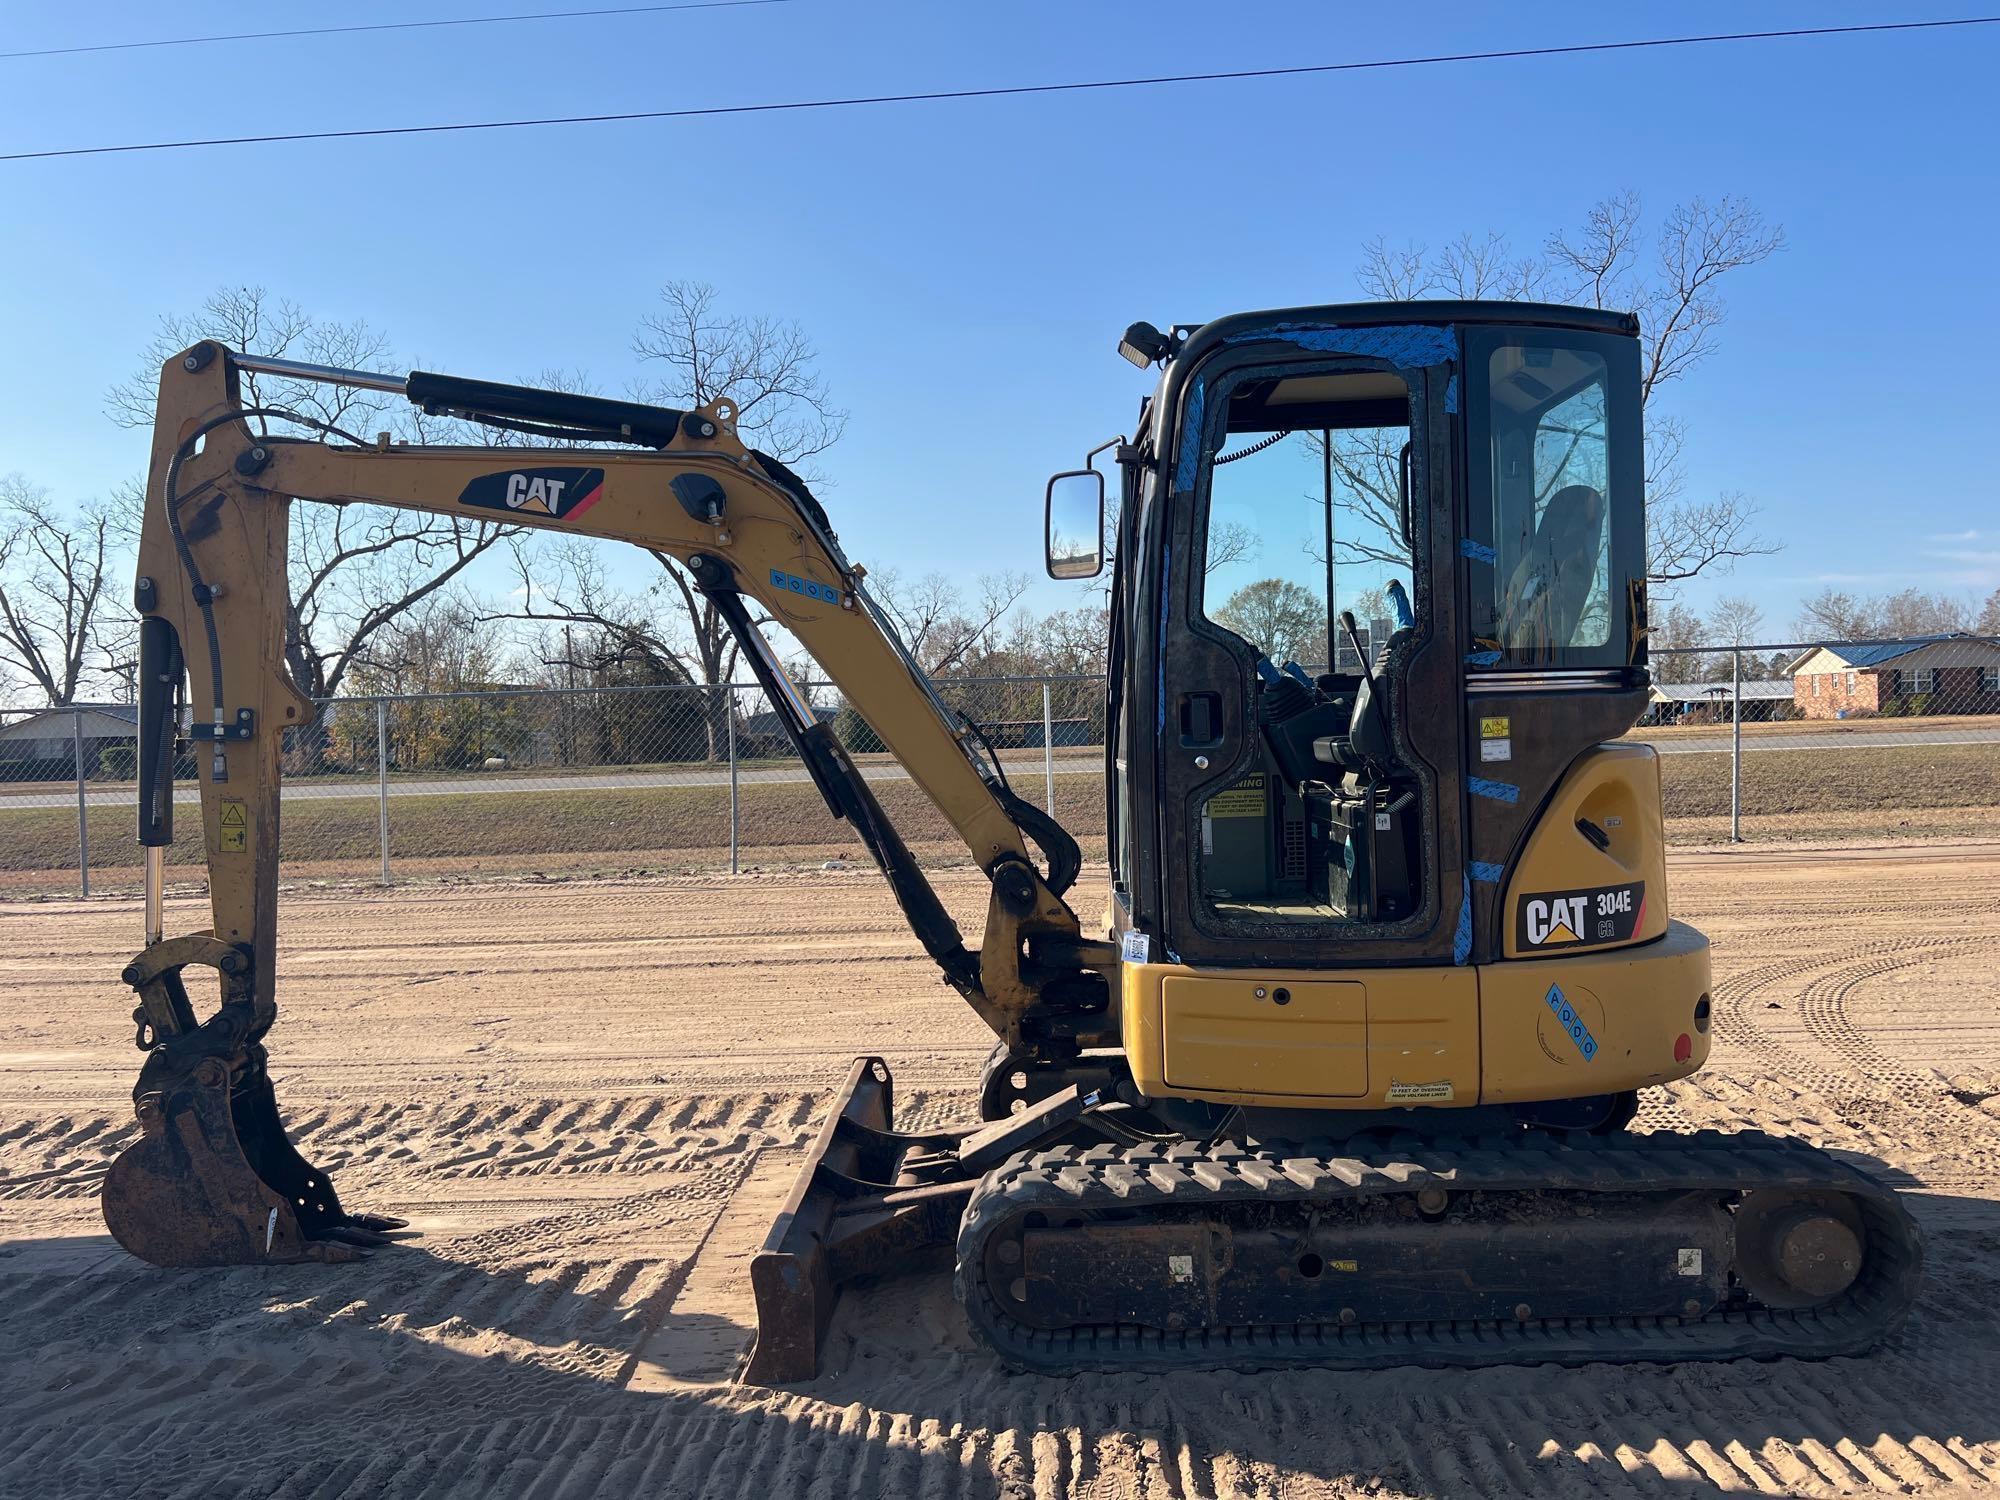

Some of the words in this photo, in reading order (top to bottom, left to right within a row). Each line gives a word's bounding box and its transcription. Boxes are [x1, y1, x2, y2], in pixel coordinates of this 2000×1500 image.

[506, 474, 566, 515] CAT
[1233, 779, 1263, 788] NING
[1526, 896, 1588, 945] CAT
[1597, 889, 1632, 916] 304E
[1597, 920, 1615, 937] CR
[1550, 991, 1593, 1055] ADDO
